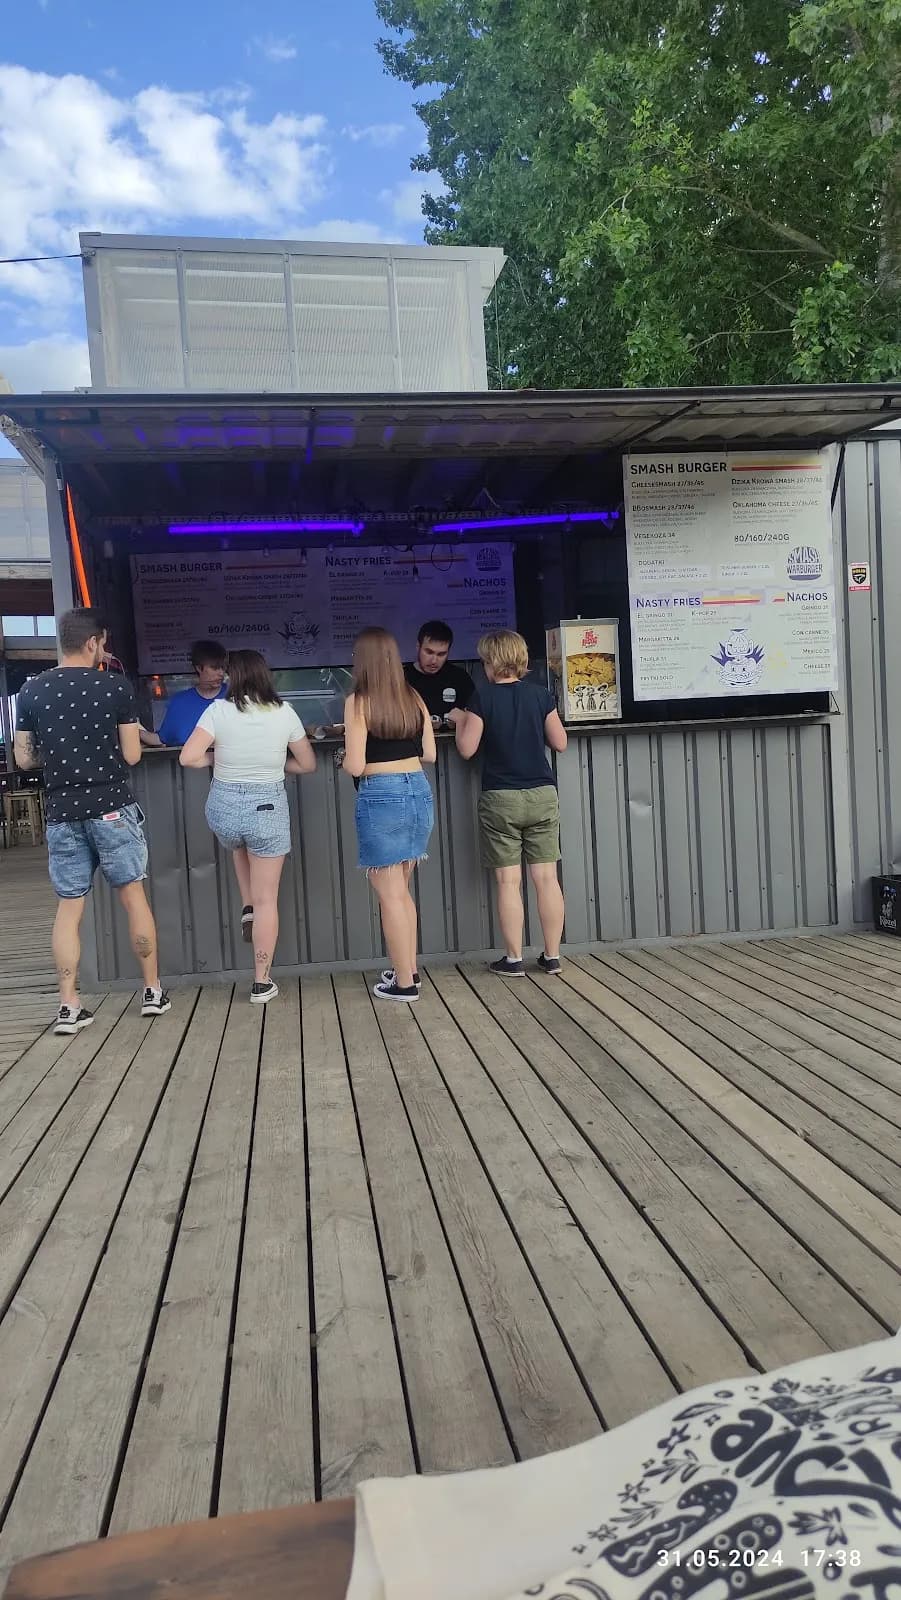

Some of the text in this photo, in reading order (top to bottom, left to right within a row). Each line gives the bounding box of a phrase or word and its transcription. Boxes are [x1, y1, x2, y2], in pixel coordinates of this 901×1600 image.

[630, 462, 727, 475] SMASH BURGER
[734, 532, 790, 543] 80/160/240G
[787, 546, 821, 564] SMASH
[325, 556, 392, 567] NASTY FRIES
[140, 562, 223, 574] SMASH BURGER
[786, 563, 823, 574] WARBURGER
[463, 577, 506, 588] NACHOS
[787, 592, 828, 602] NACHOS
[636, 597, 701, 609] NASTY FRIES
